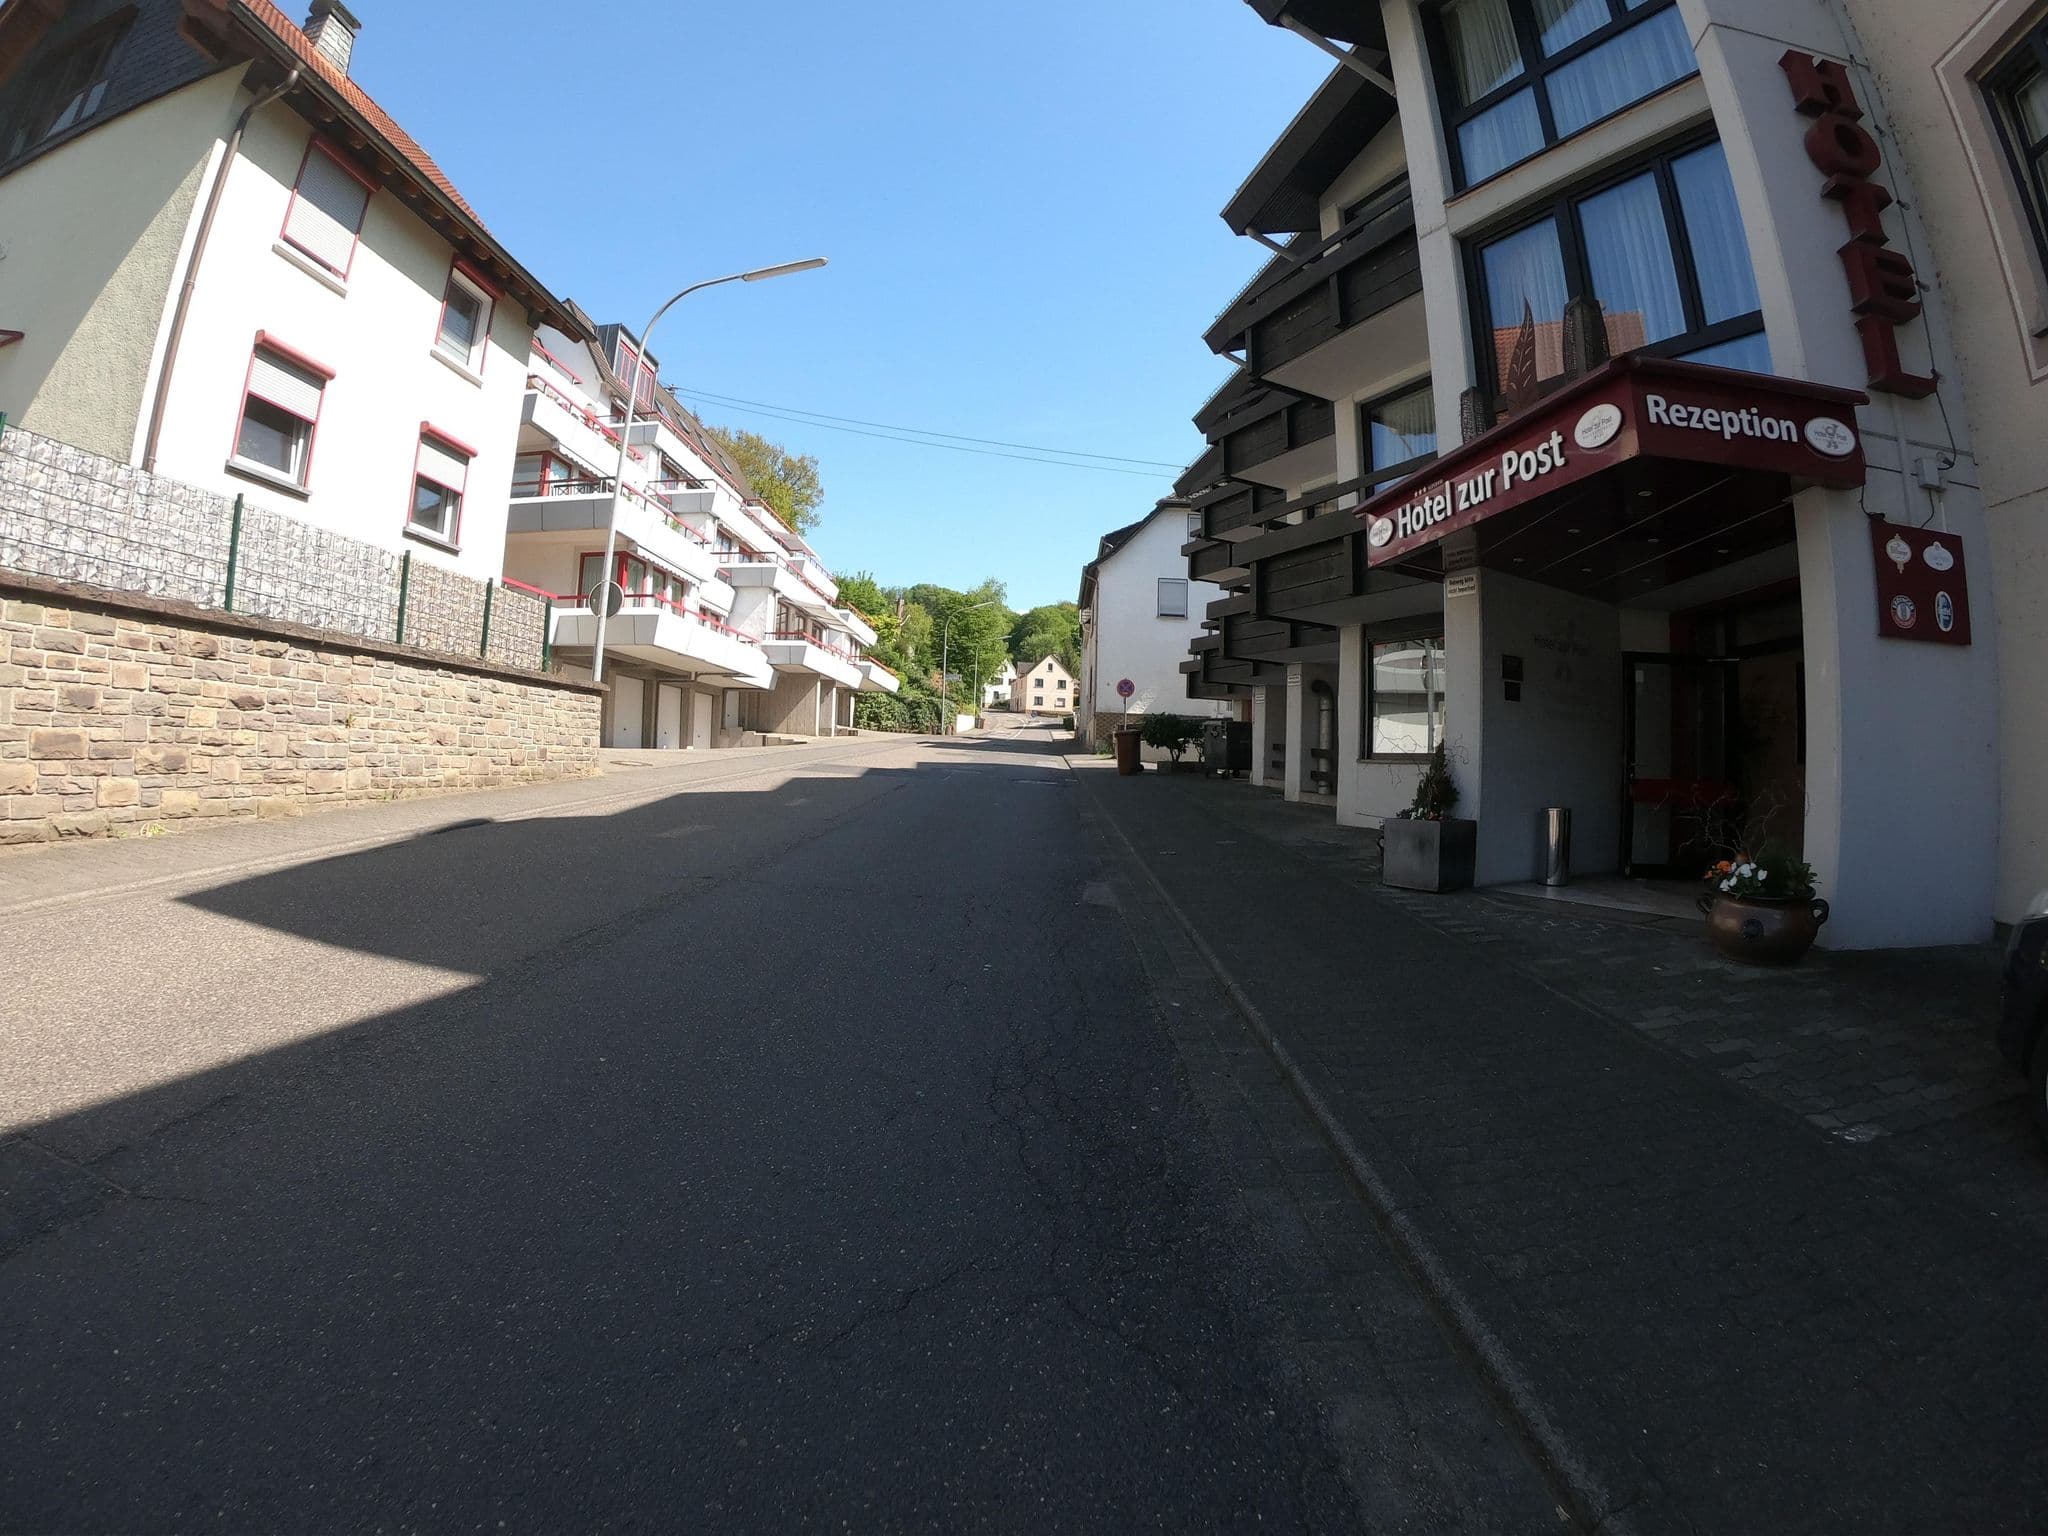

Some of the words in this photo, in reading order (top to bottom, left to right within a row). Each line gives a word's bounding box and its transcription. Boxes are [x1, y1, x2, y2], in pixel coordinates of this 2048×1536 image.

[1778, 49, 1939, 400] HOTEL
[1646, 394, 1798, 442] Rezeption
[1398, 481, 1451, 537] Hotel
[1457, 468, 1496, 511] zur
[1502, 431, 1565, 490] Post
